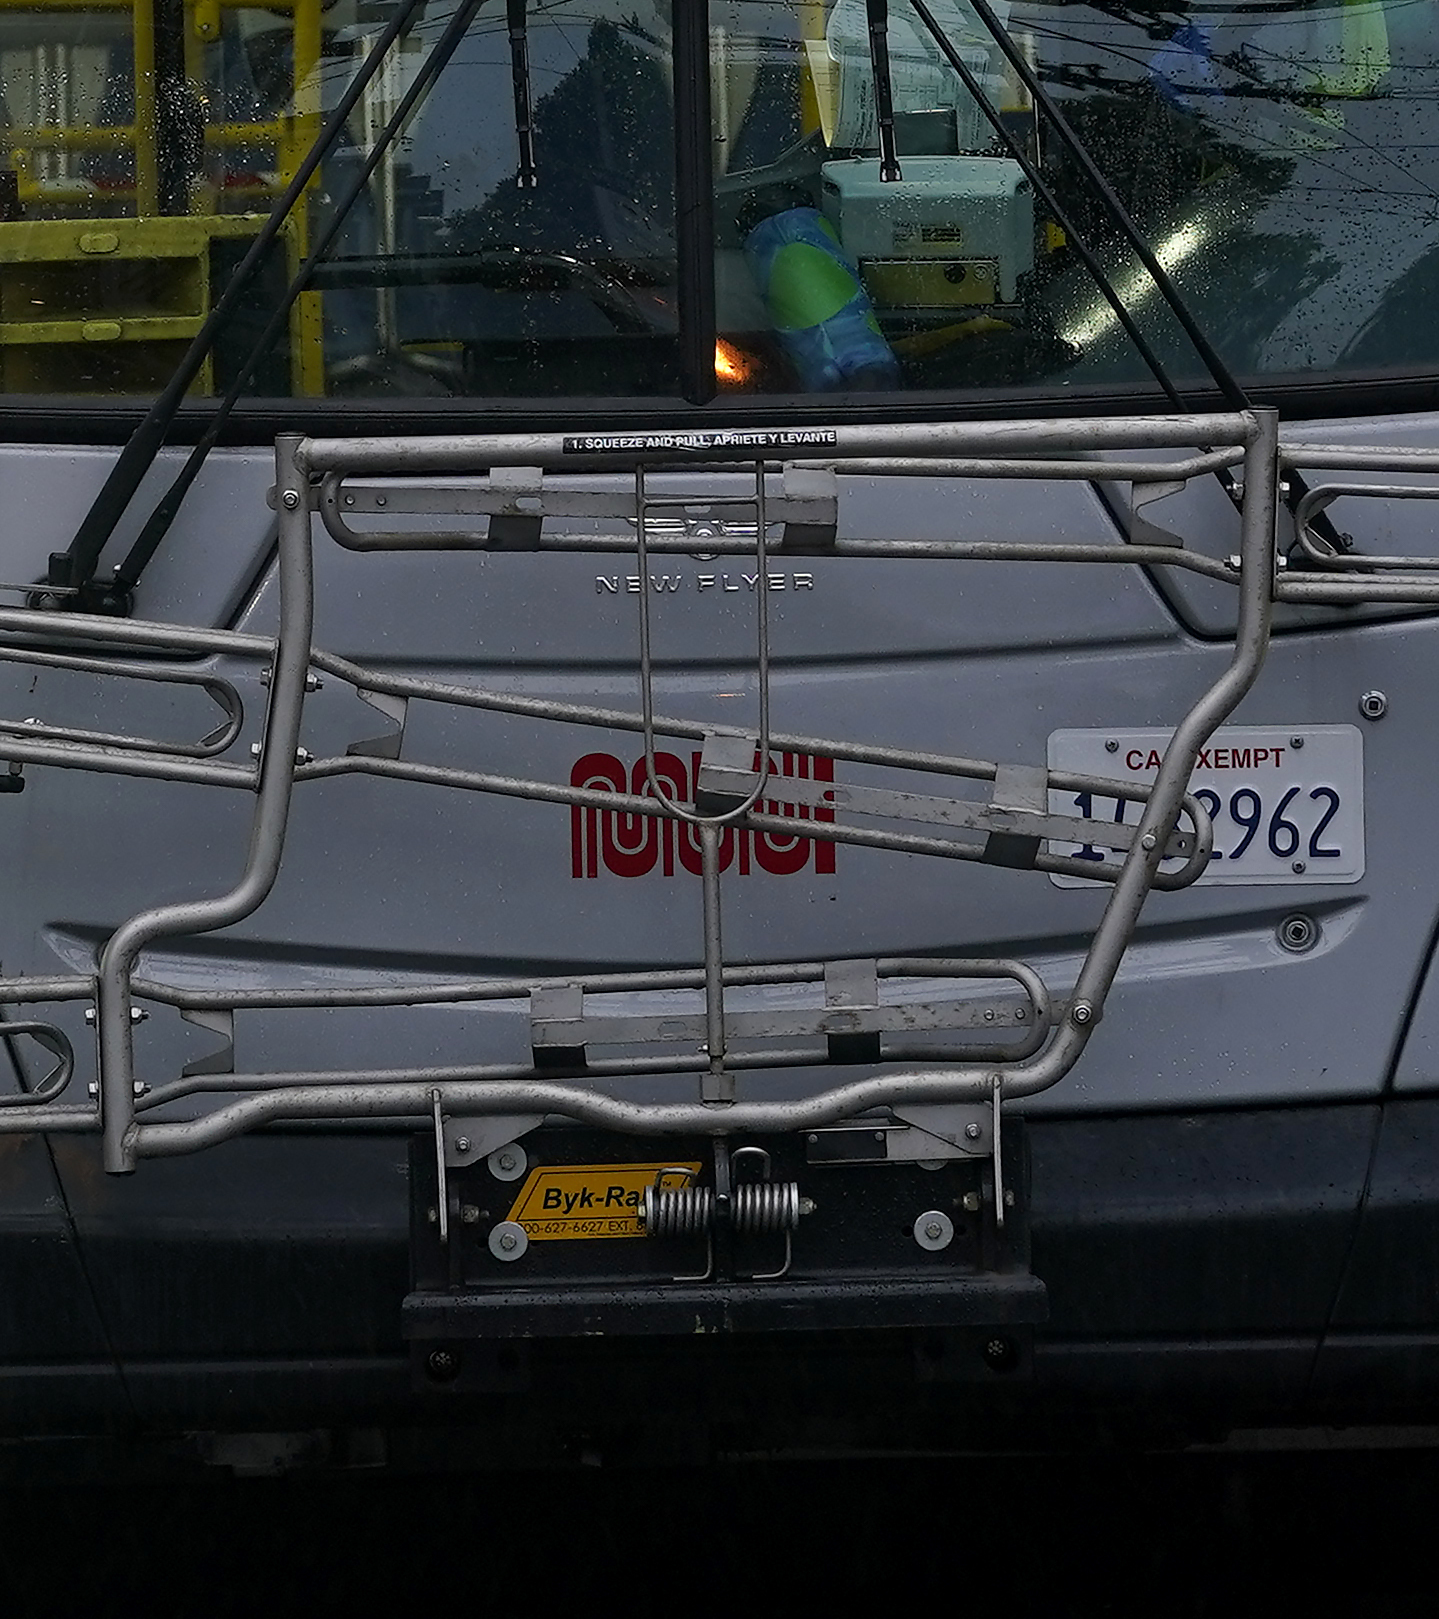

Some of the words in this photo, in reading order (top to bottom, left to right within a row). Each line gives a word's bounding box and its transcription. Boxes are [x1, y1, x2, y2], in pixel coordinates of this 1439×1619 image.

[585, 437, 644, 449] SQUEEZE
[646, 436, 673, 448] AND
[713, 433, 767, 446] APRIETE
[768, 433, 779, 444] Y
[780, 432, 836, 444] LEVANTE
[595, 575, 682, 594] NEW
[697, 572, 814, 592] FLYER
[1125, 749, 1162, 771] CA
[1194, 746, 1286, 770] XEMPT
[1071, 785, 1342, 862] 12962
[542, 1186, 647, 1215] Byk-Ra
[519, 1221, 603, 1235] 00-627-6627
